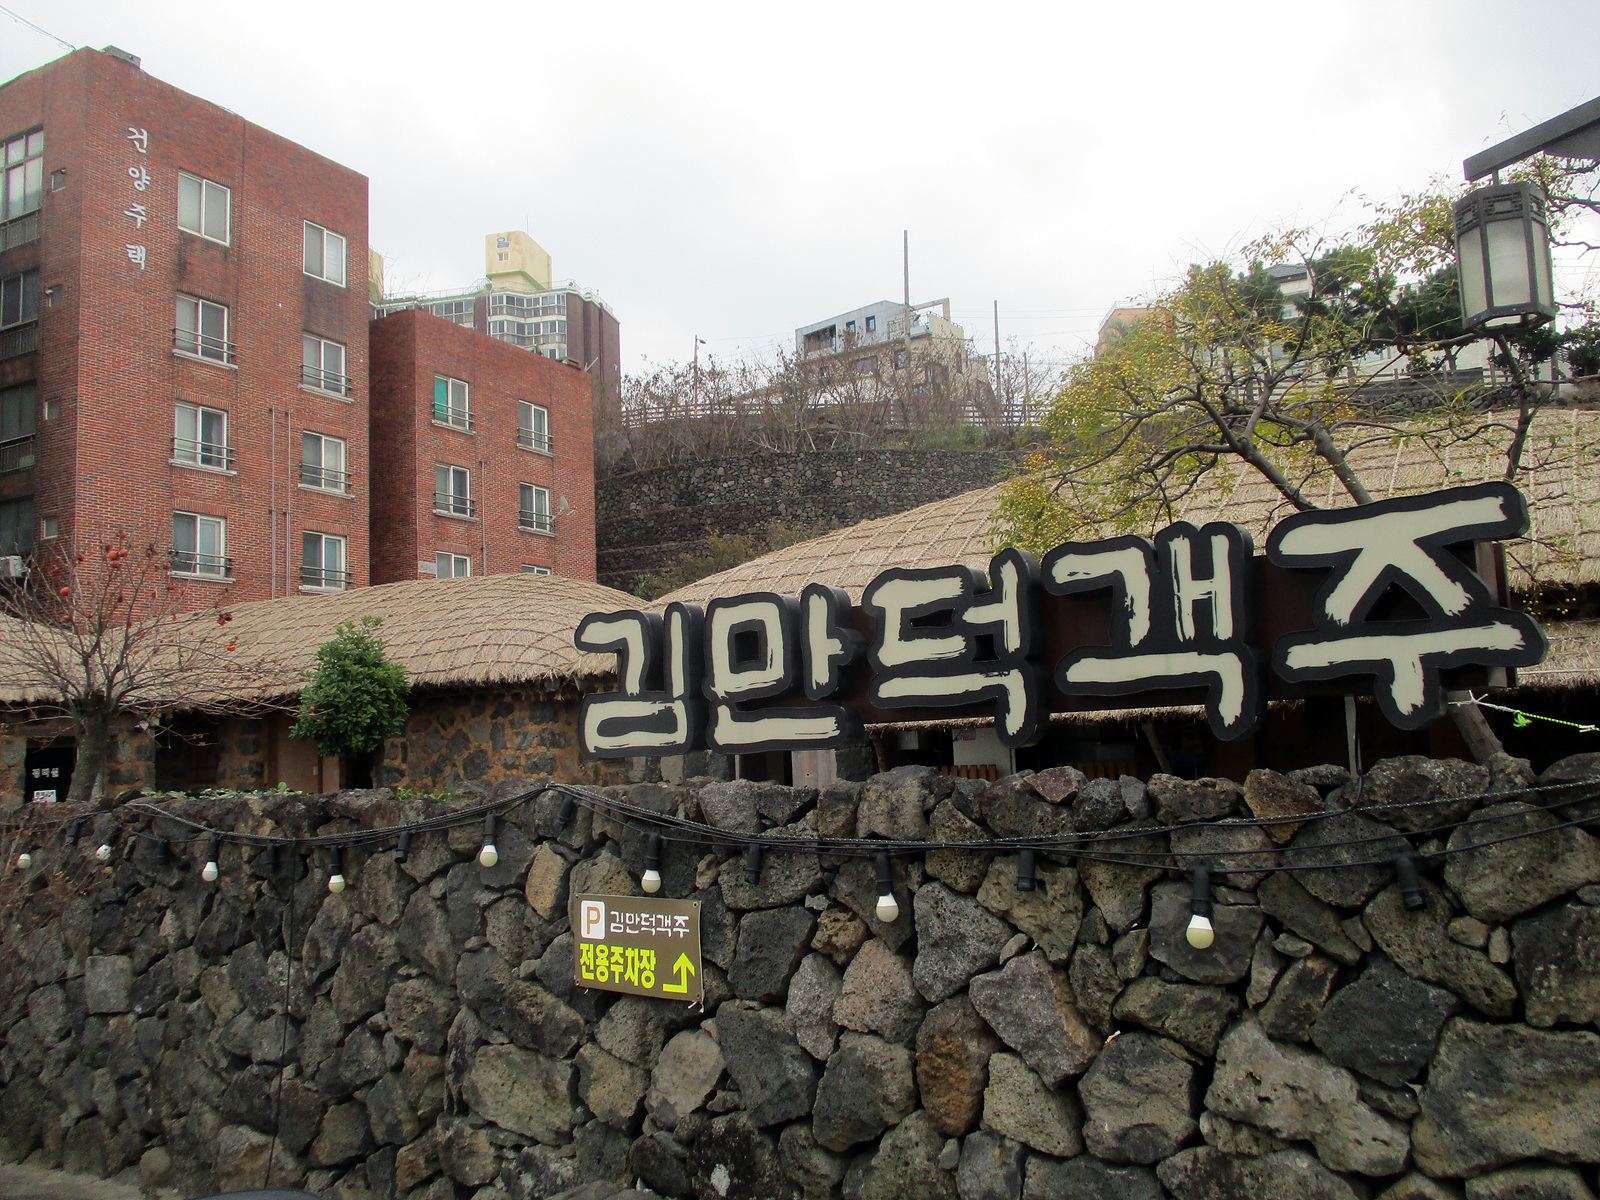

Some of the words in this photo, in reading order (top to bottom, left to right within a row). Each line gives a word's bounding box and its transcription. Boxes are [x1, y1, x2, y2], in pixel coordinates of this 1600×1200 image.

[577, 493, 1528, 754] 김만덕객주
[586, 906, 601, 935] P
[610, 910, 690, 939] 김만덕객주
[580, 943, 657, 989] 전용주차장
